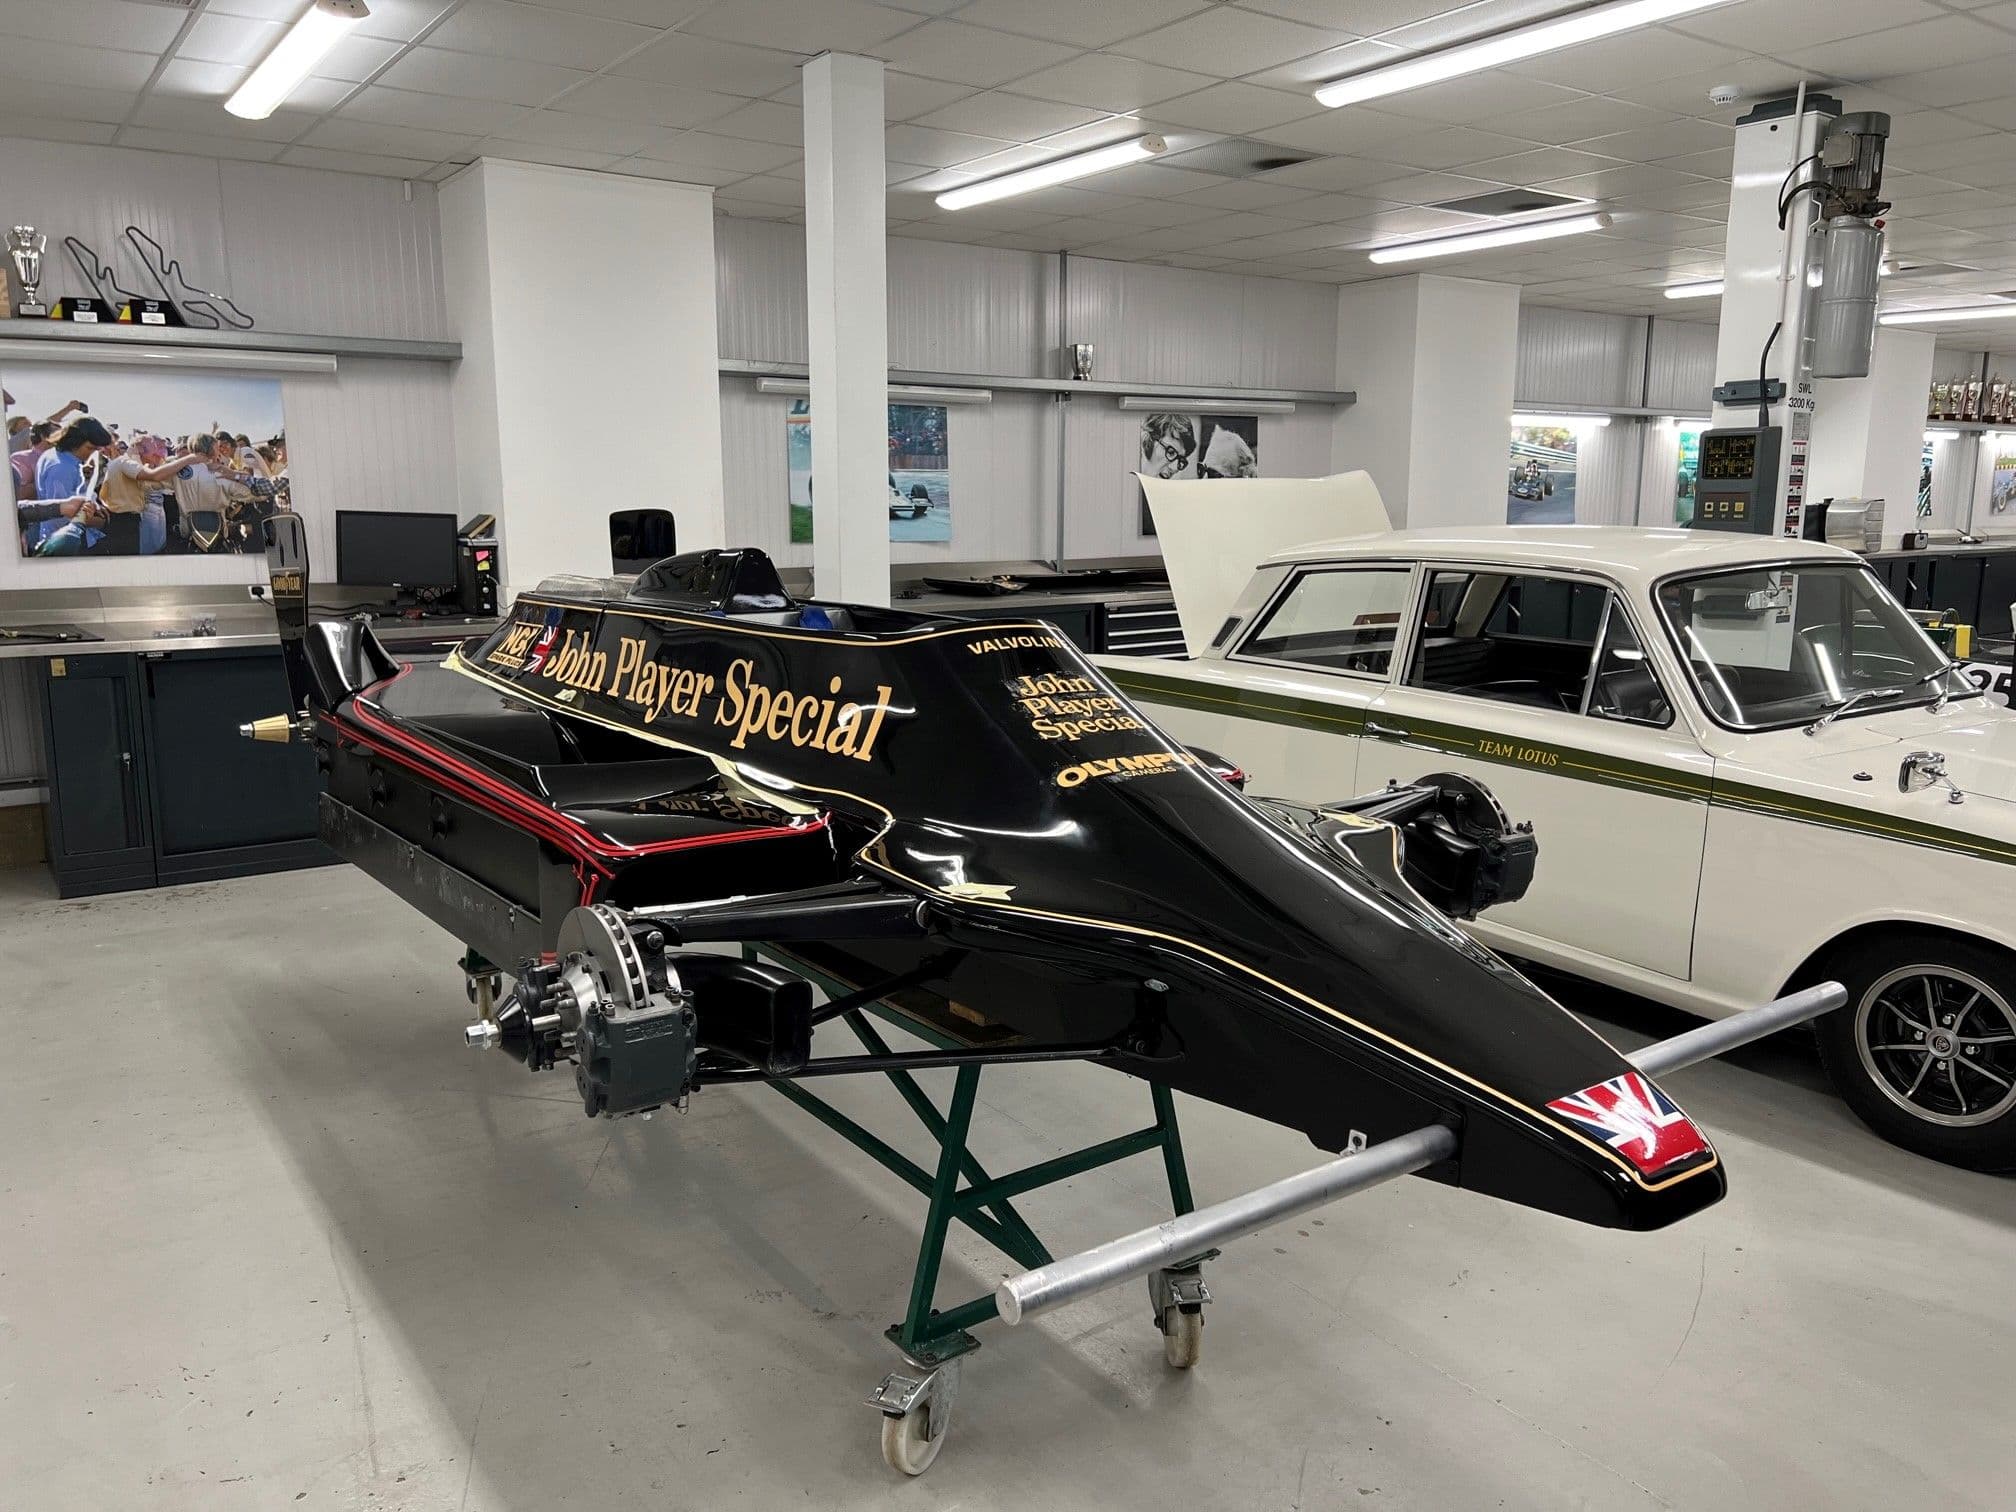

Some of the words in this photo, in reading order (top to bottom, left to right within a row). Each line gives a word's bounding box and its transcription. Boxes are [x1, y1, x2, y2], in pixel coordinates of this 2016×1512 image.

[1798, 382, 1812, 394] SWL
[1788, 397, 1805, 409] 3200
[498, 625, 540, 658] NGK
[967, 636, 1067, 655] VALVOLIN
[542, 627, 607, 692] John
[608, 636, 715, 723] Player
[713, 657, 895, 763] Special
[1018, 672, 1097, 697] John
[1017, 695, 1121, 719] Player
[1031, 712, 1148, 741] Specia
[1478, 739, 1514, 758] TEAM
[1517, 747, 1559, 767] LOTUS
[1056, 752, 1196, 788] OLYMPU
